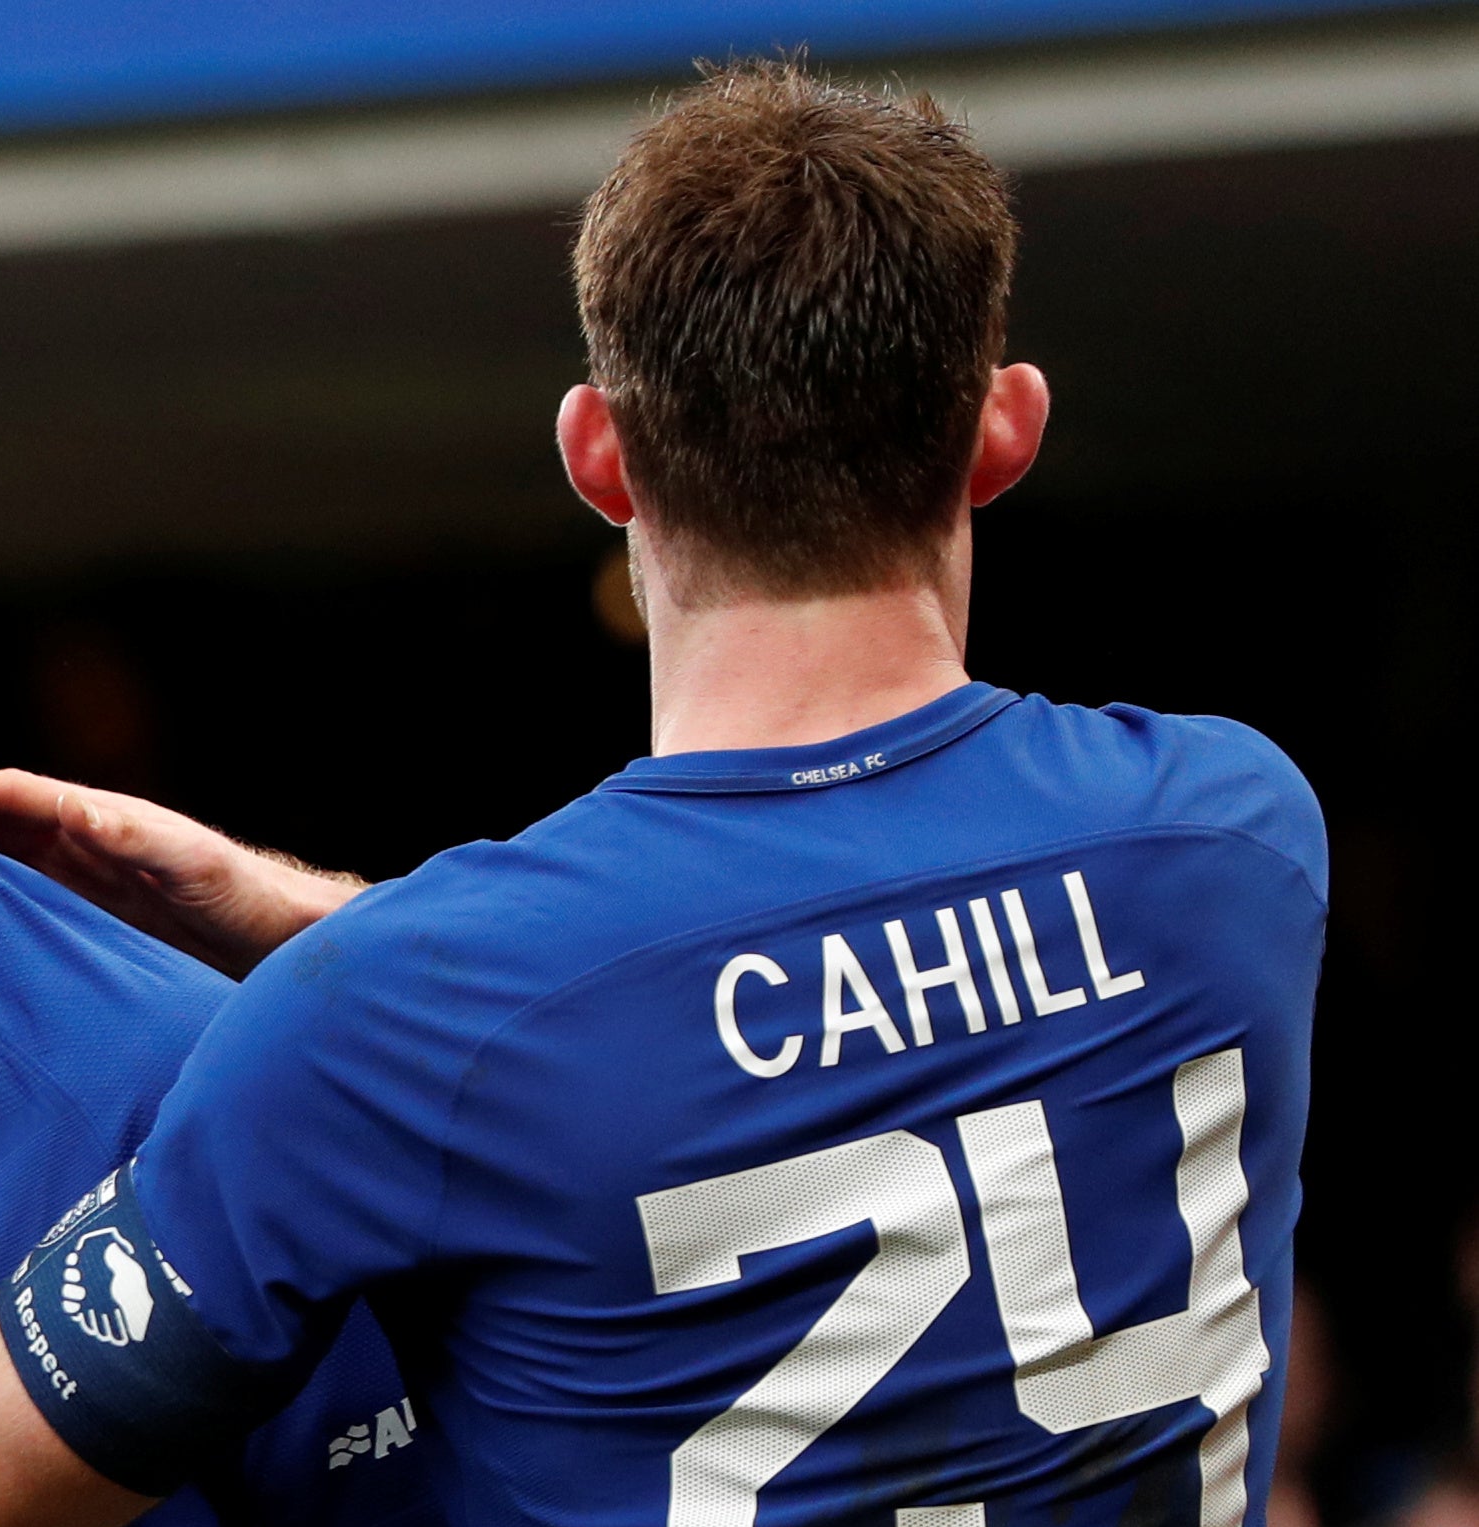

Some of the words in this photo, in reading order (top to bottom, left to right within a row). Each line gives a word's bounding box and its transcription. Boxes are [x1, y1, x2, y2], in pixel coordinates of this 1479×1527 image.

[792, 762, 861, 785] CHELSEA
[864, 753, 886, 769] FC
[714, 871, 1145, 1079] CAHILL
[15, 1287, 77, 1400] Respect
